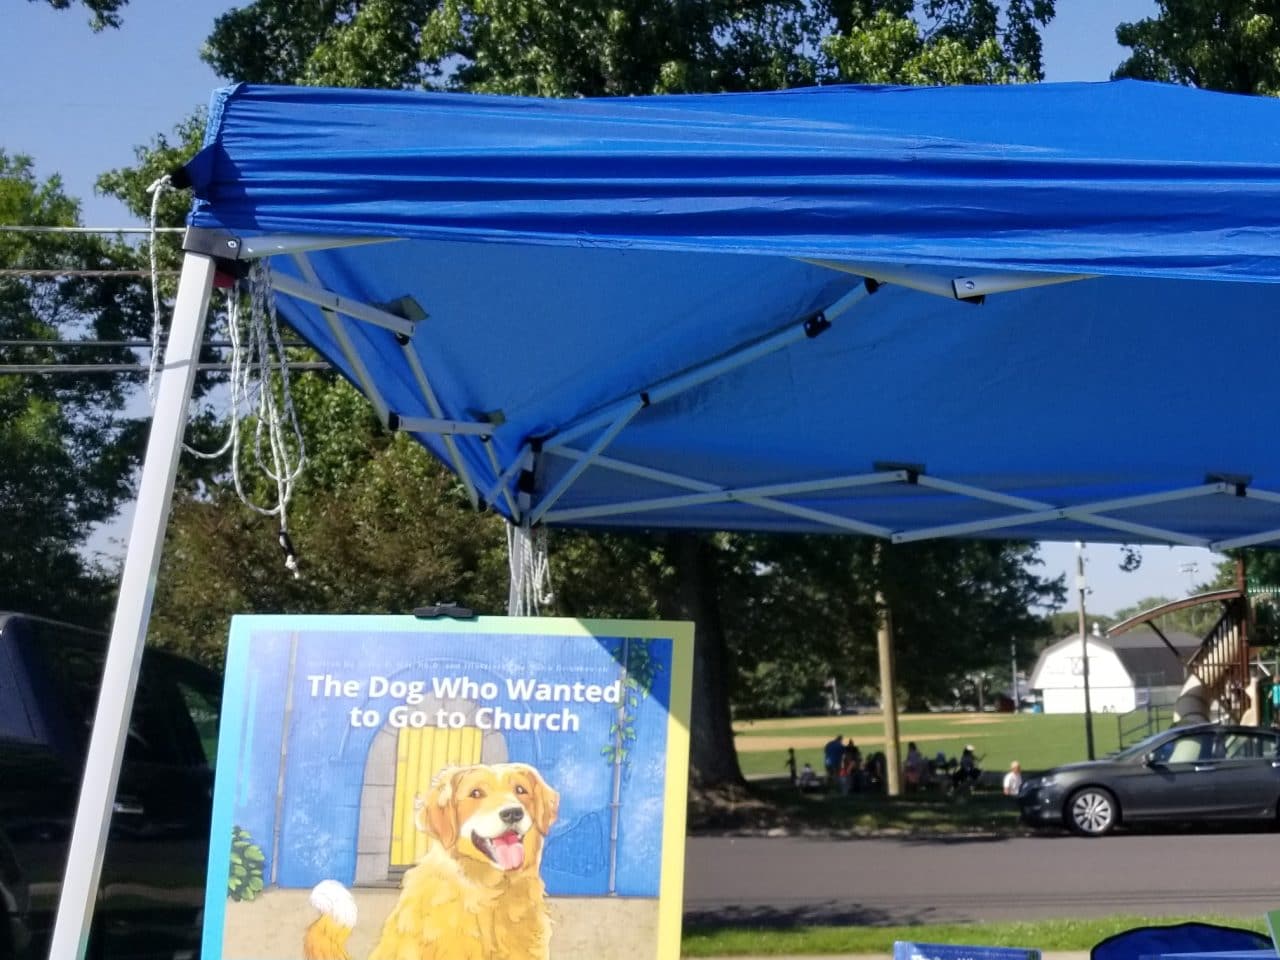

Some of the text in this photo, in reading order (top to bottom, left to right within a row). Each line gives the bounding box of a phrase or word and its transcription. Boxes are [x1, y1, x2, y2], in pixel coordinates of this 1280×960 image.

[307, 674, 621, 705] The Dog Who Wanted
[350, 705, 580, 733] to Go to Church
